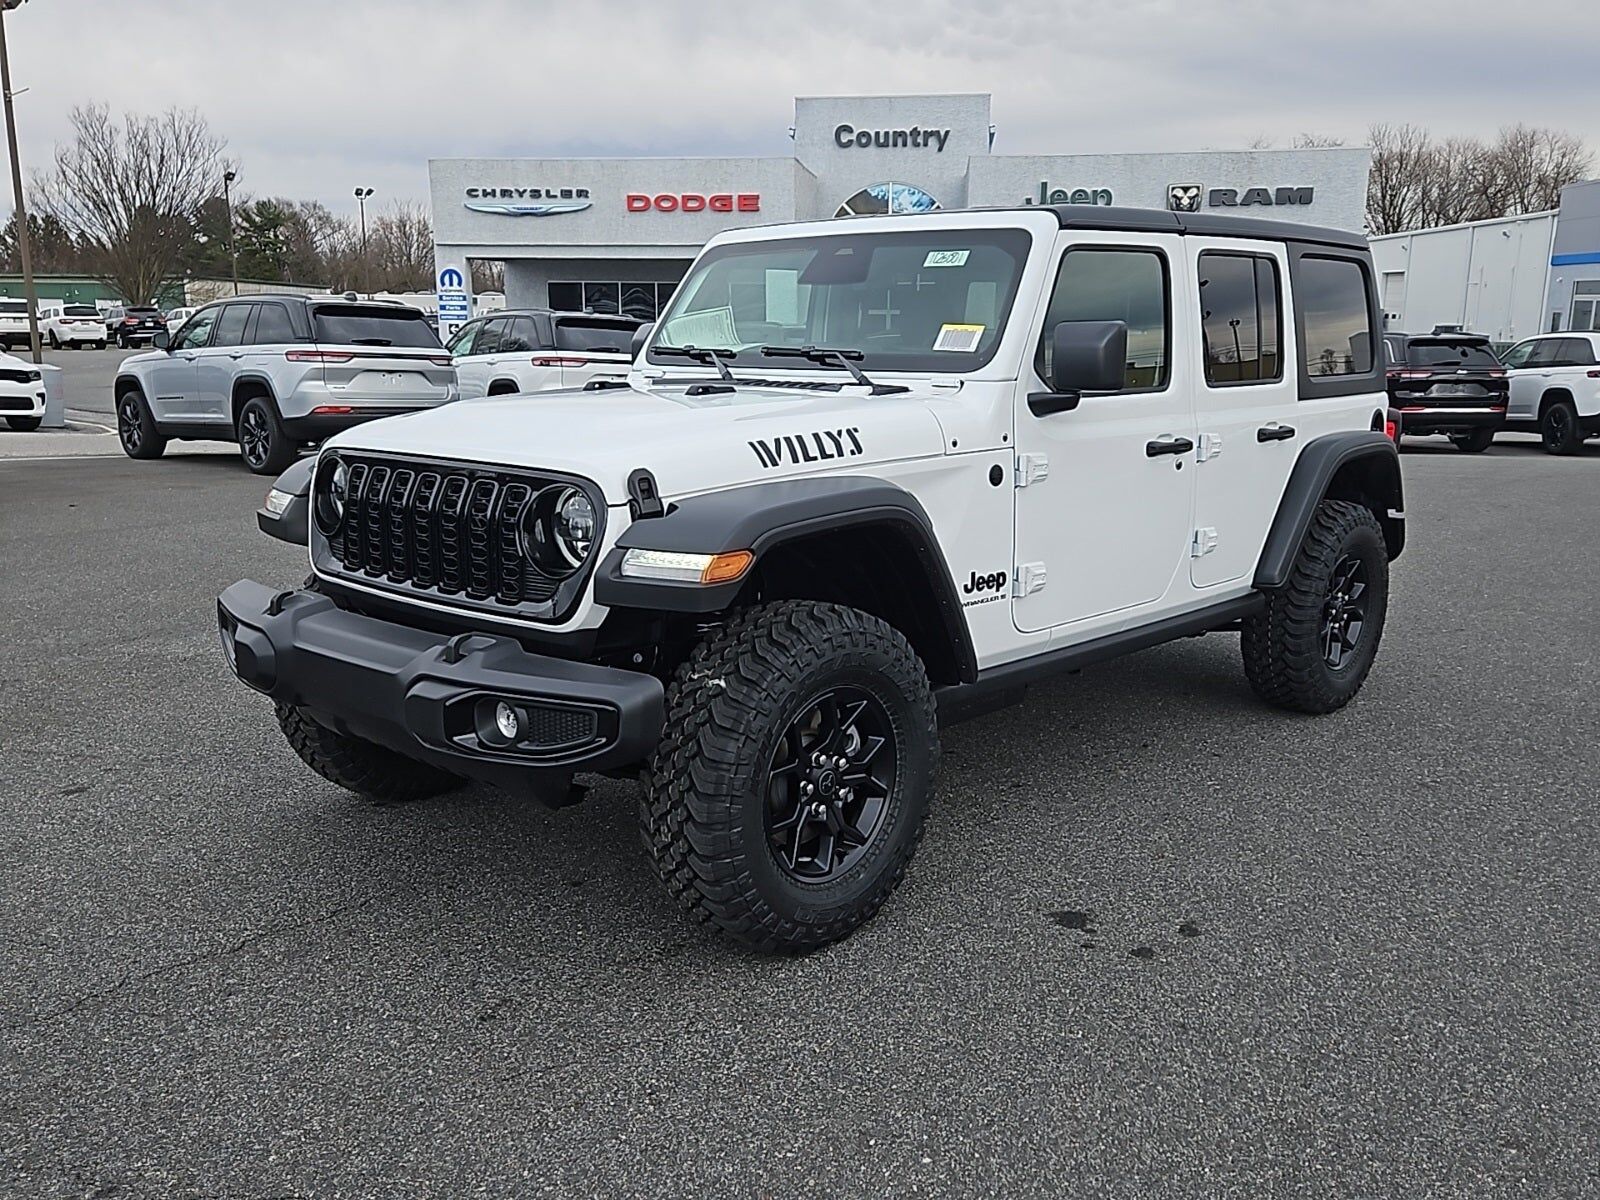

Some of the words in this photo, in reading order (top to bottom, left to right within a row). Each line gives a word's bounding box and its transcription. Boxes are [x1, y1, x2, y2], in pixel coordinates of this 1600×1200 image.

[834, 124, 951, 152] Country
[465, 188, 591, 199] CHRYSLER
[626, 194, 760, 212] DODGE
[1208, 187, 1315, 207] RAM
[747, 427, 864, 468] WILLYS
[963, 571, 1007, 594] Jeep
